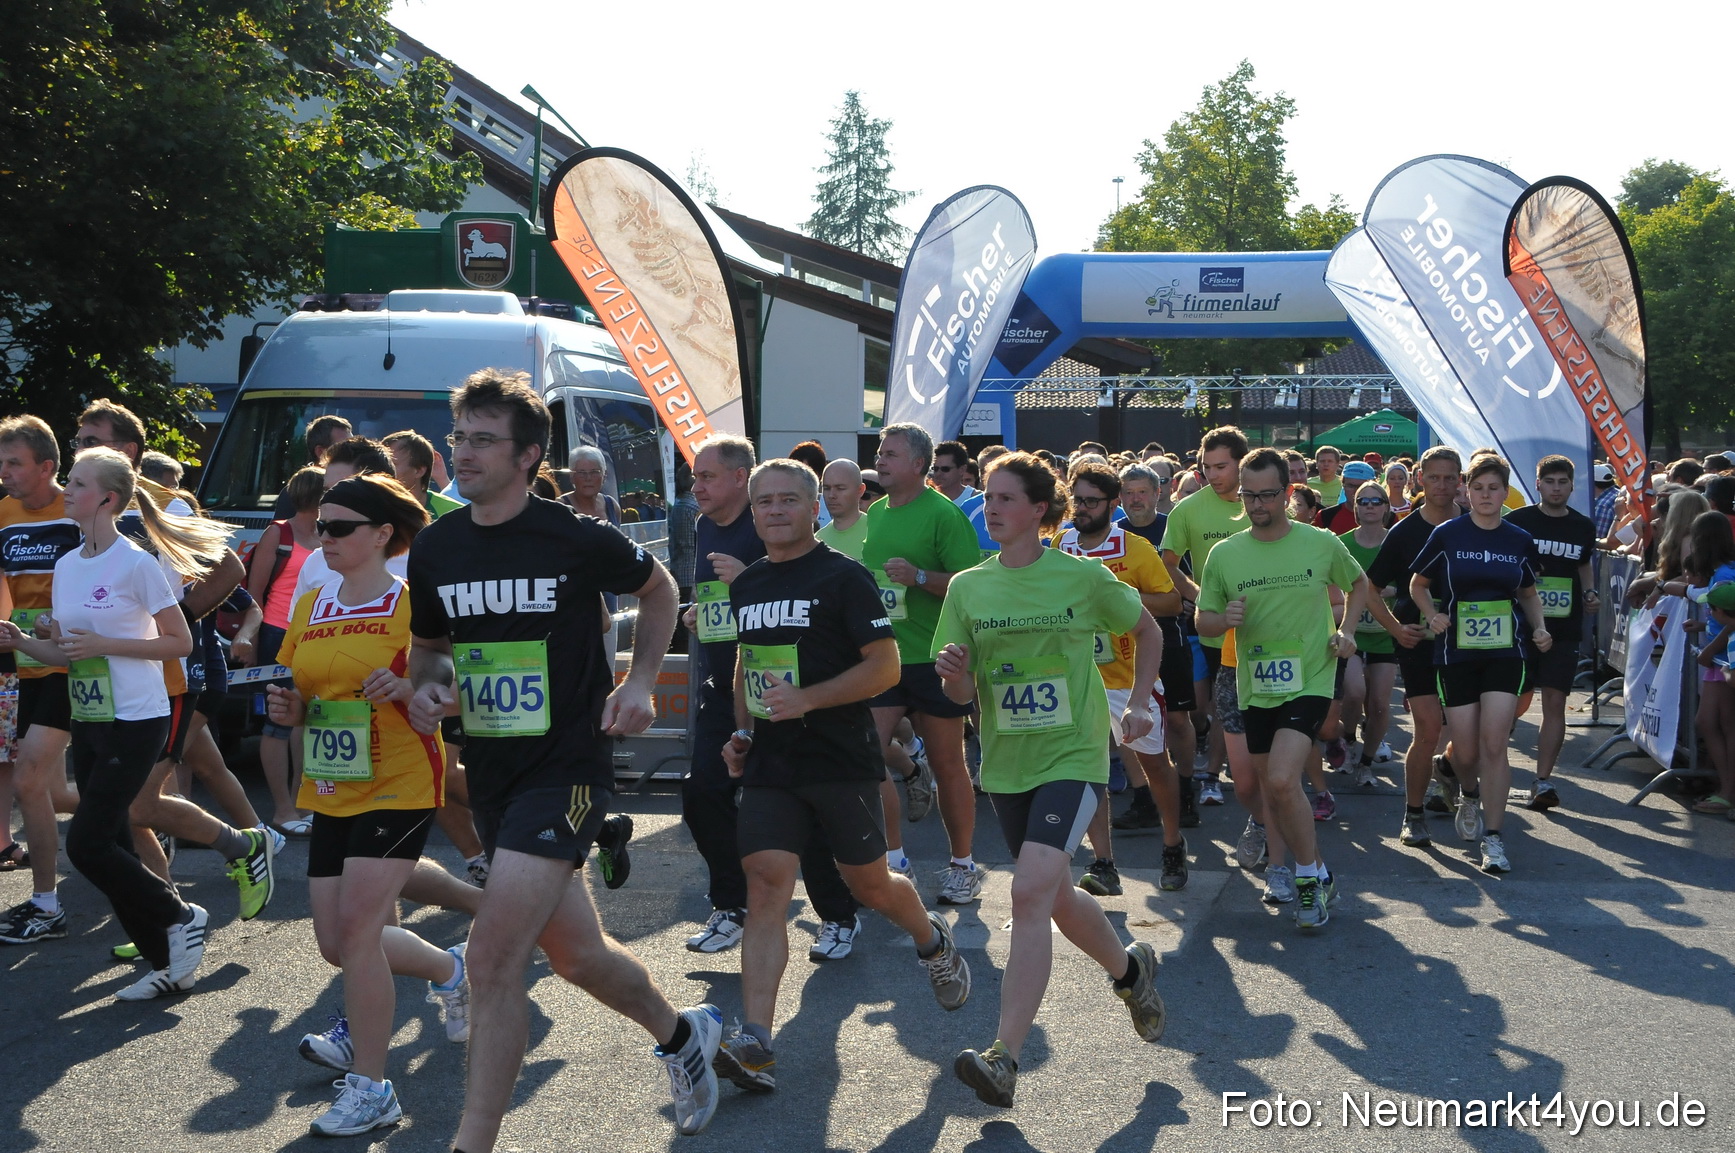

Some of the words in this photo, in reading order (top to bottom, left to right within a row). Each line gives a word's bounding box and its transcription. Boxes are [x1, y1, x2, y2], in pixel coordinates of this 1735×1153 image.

[473, 272, 498, 282] 1628
[927, 222, 1006, 378] Fischer
[1183, 293, 1282, 311] firmenlauf
[957, 252, 1015, 375] AUTOMOBILE
[10, 543, 60, 556] Fischer
[12, 554, 55, 562] AUTOMOBILE
[1456, 551, 1483, 560] EURO
[1492, 553, 1518, 564] POLES
[1237, 573, 1309, 591] globalconcepts
[437, 578, 557, 618] THULE
[739, 600, 811, 632] THULE
[975, 612, 1070, 634] globalconcepts
[301, 626, 338, 643] MAX
[341, 621, 390, 636] BÖGL
[1465, 618, 1502, 637] 321
[1254, 660, 1294, 683] 448
[71, 680, 104, 706] 434
[460, 675, 544, 713] 1405
[1002, 682, 1058, 715] 443
[309, 728, 357, 761] 799
